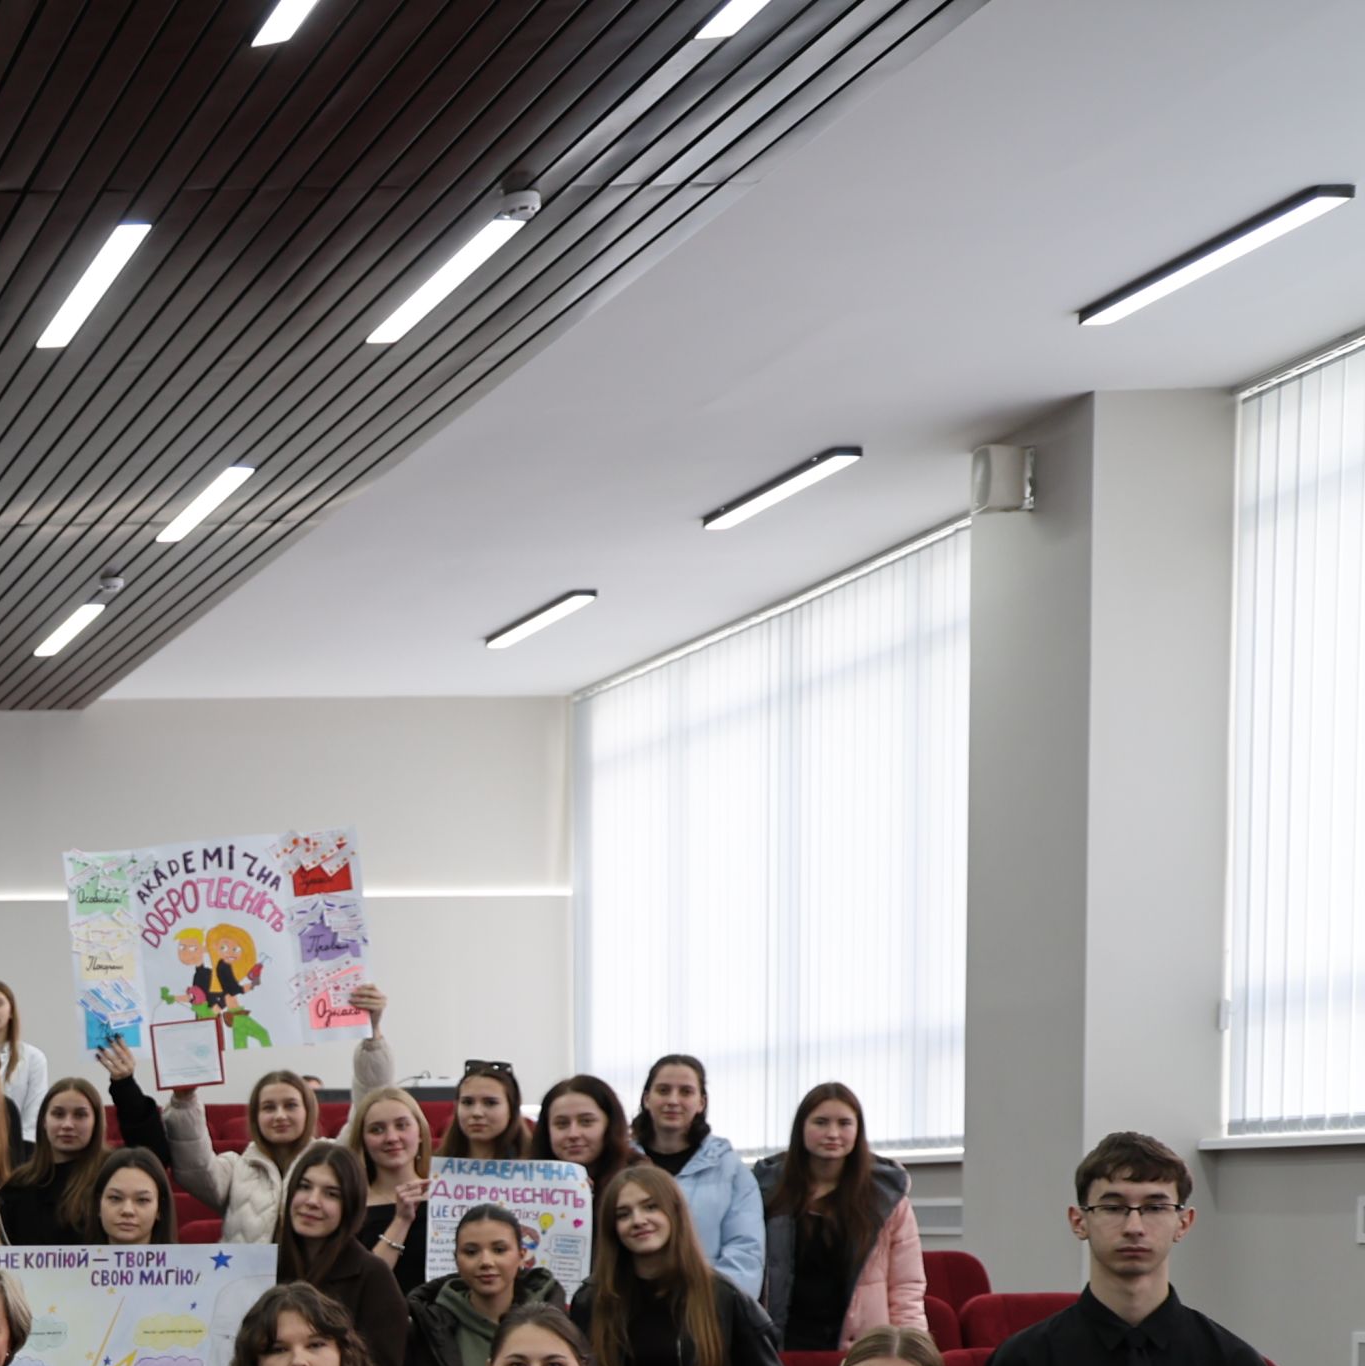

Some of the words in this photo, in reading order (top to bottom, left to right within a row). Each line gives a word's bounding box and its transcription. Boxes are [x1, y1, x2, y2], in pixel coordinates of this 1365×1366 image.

[441, 1158, 579, 1182] АКАДЕМІЧНА
[430, 1180, 586, 1209] ДОБРОЧЕСНІСТЬ
[24, 1248, 90, 1270] КОПІЮЙ
[114, 1250, 167, 1267] ТВОРИ
[91, 1268, 135, 1287] СВОЮ
[138, 1267, 201, 1287] МАГІЮ!
